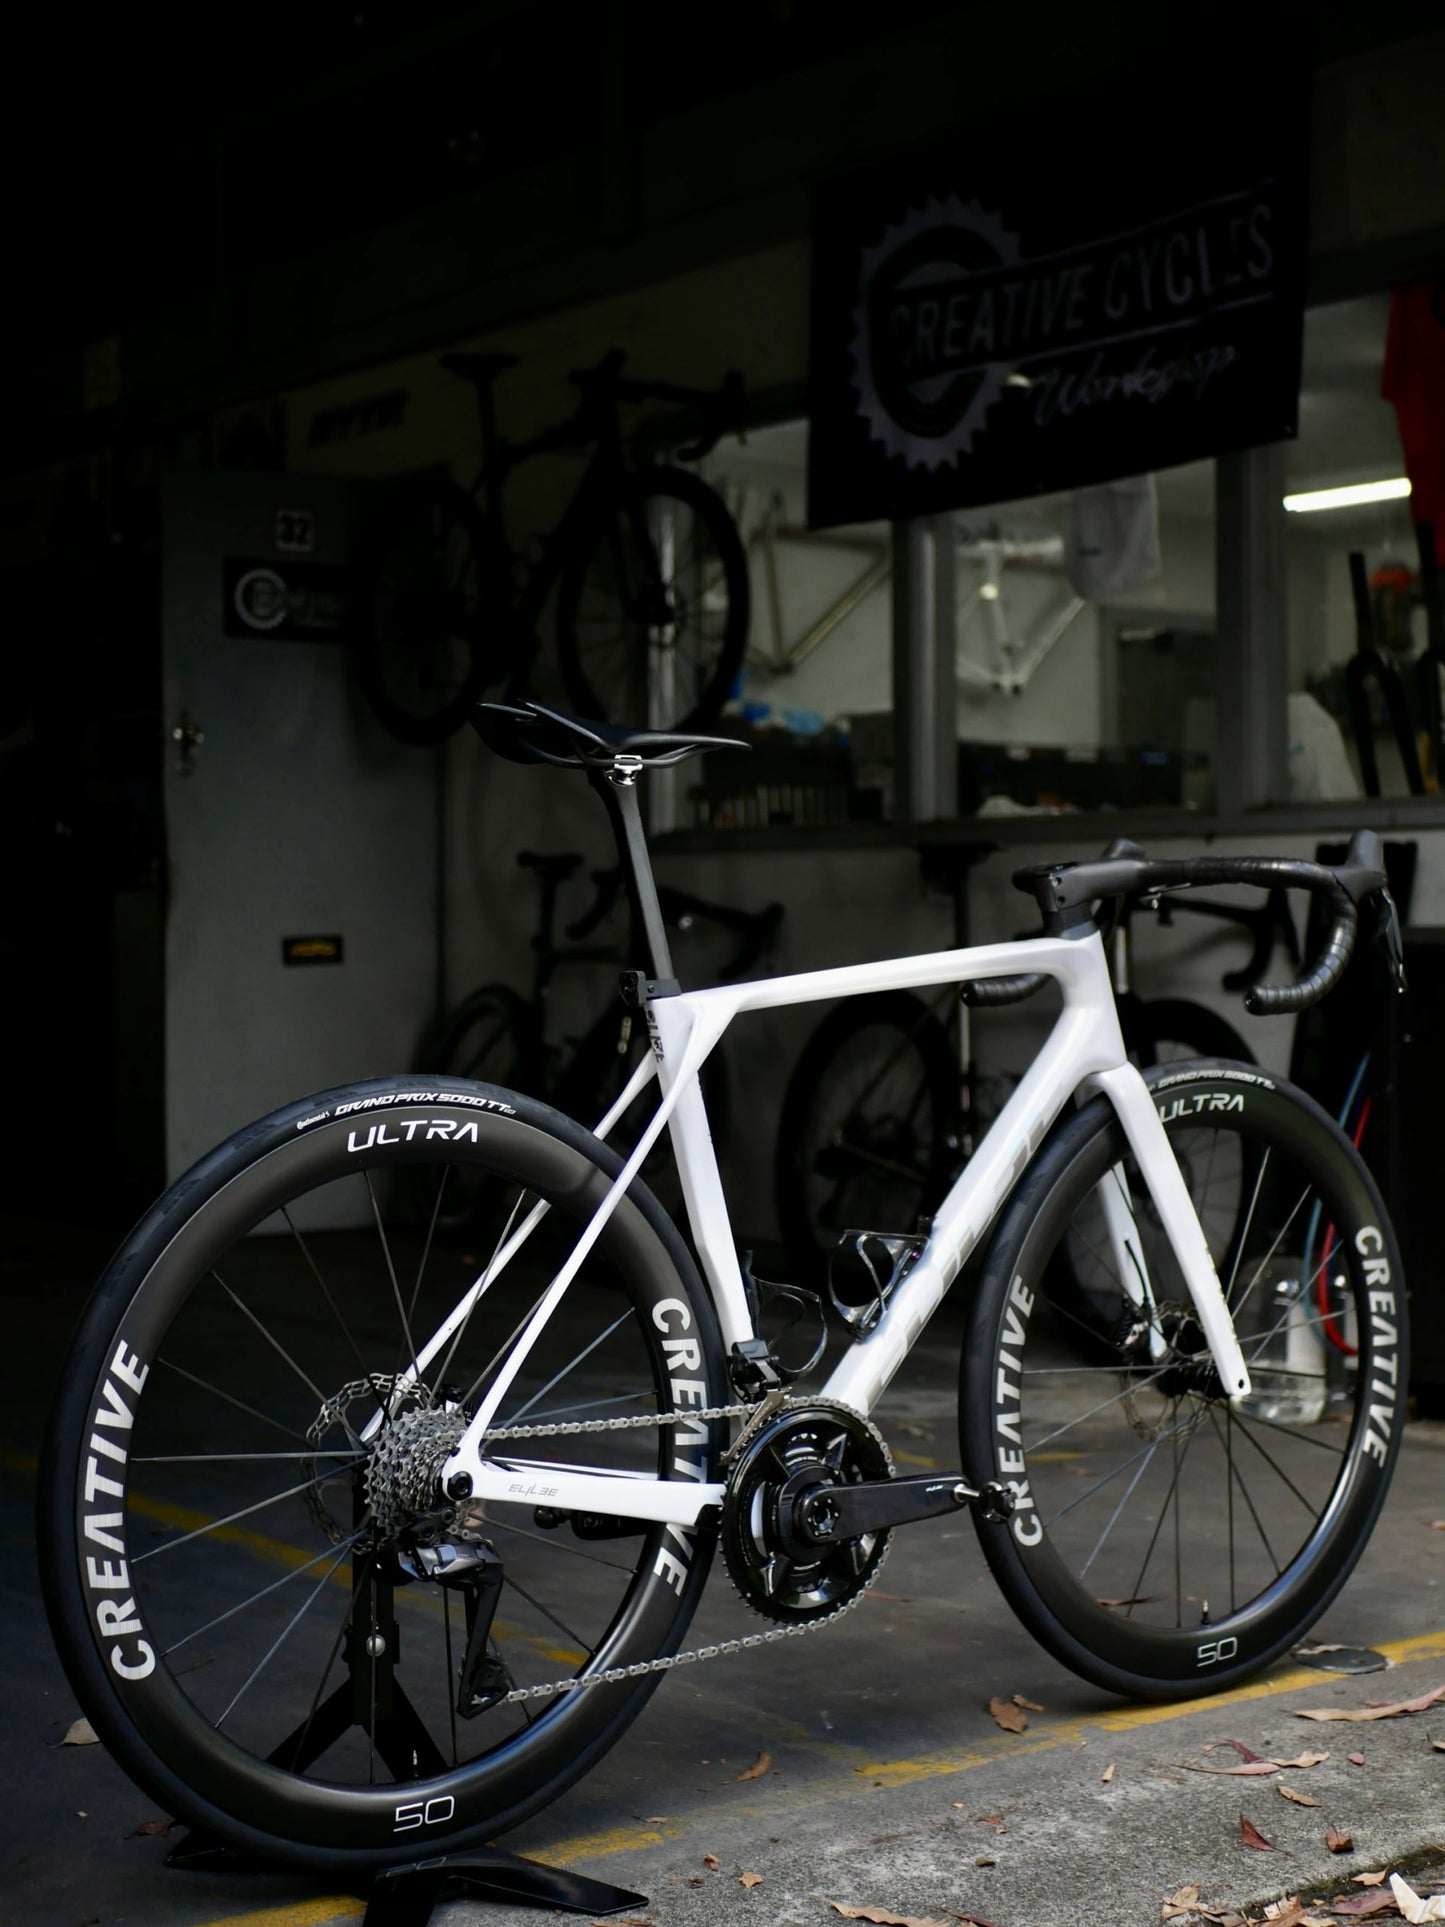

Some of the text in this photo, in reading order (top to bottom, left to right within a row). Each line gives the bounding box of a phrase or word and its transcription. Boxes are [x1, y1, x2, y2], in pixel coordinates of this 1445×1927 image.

[888, 261, 1097, 369] CREATIVE
[334, 1094, 398, 1116] GRAND
[394, 1092, 439, 1104] PRIX
[437, 1093, 485, 1107] 5000
[1158, 1093, 1245, 1124] ULTRA
[346, 1119, 479, 1153] ULTRA
[1355, 1225, 1398, 1469] CREATIVE
[996, 1274, 1044, 1547] CREATIVE
[83, 1339, 157, 1681] CREATIVE
[1196, 1636, 1239, 1668] 50
[393, 1795, 456, 1833] 50
